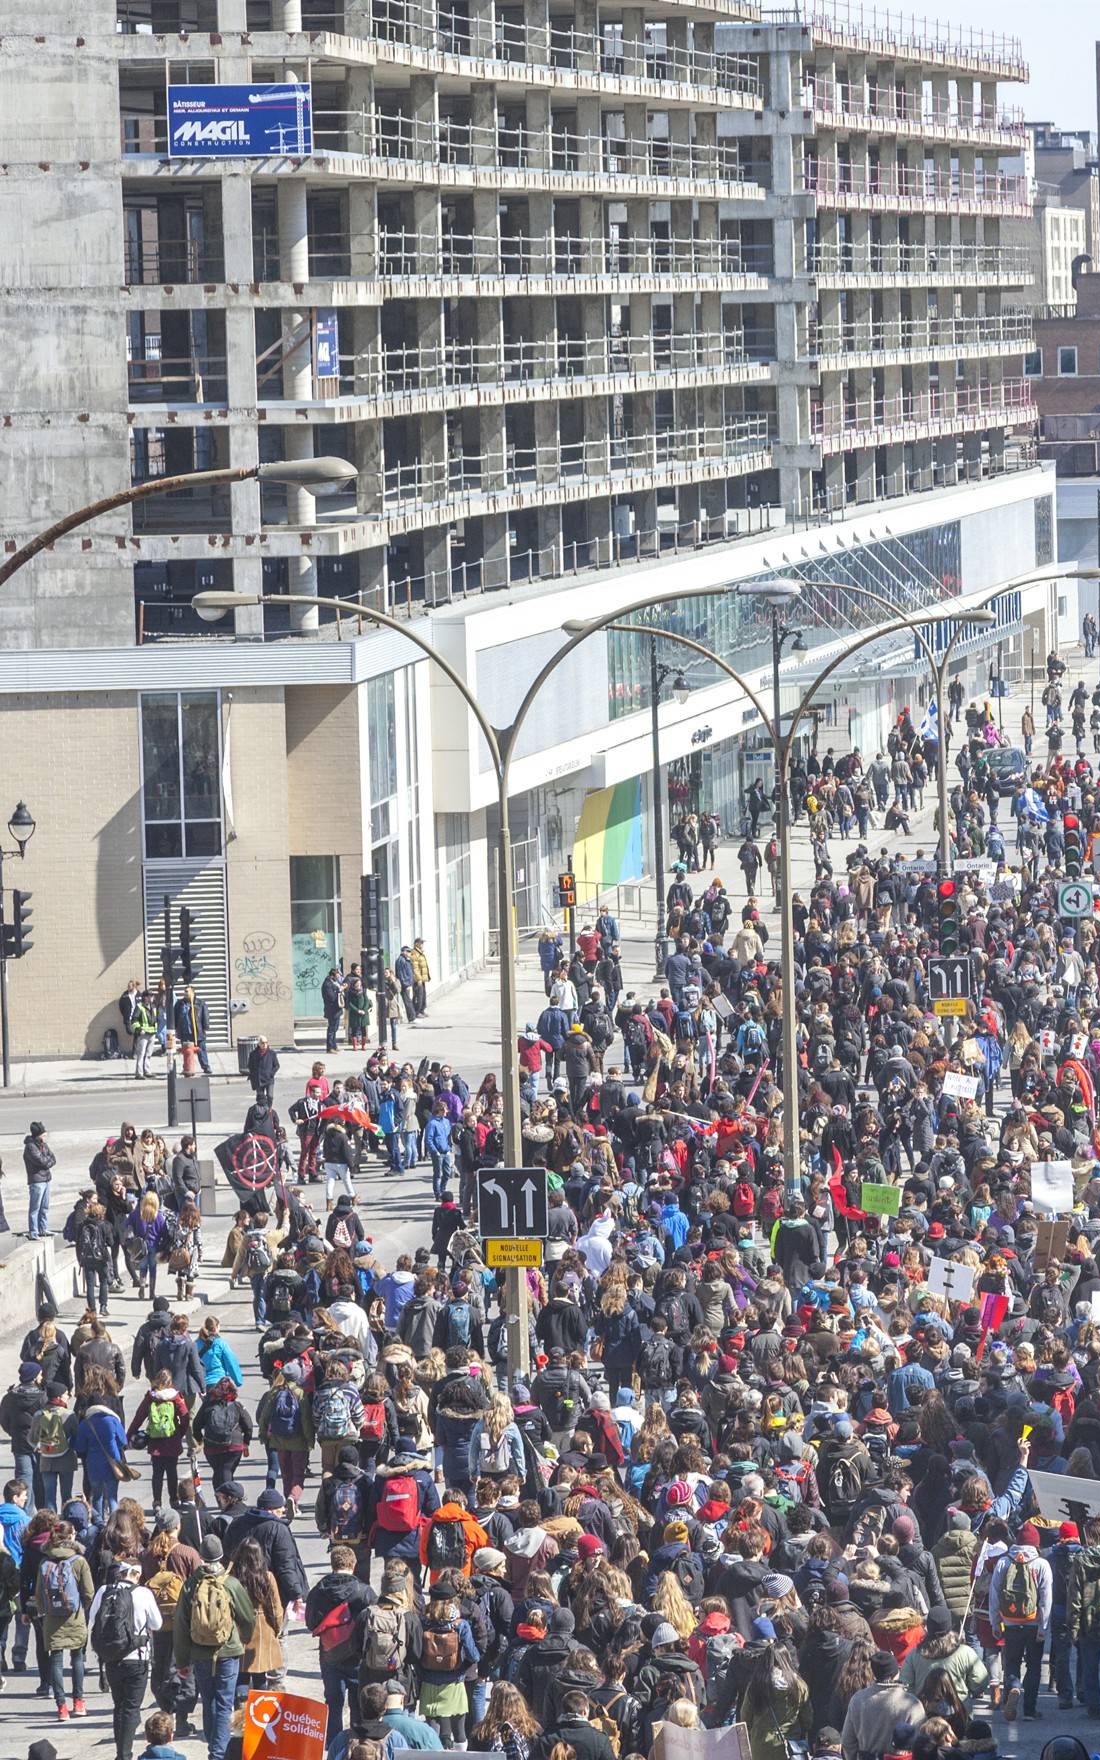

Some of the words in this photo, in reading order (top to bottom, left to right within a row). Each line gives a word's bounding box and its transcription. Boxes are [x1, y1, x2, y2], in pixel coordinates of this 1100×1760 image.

[966, 862, 990, 870] Ontario
[283, 1710, 321, 1729] Québec
[282, 1722, 324, 1741] solidaire
